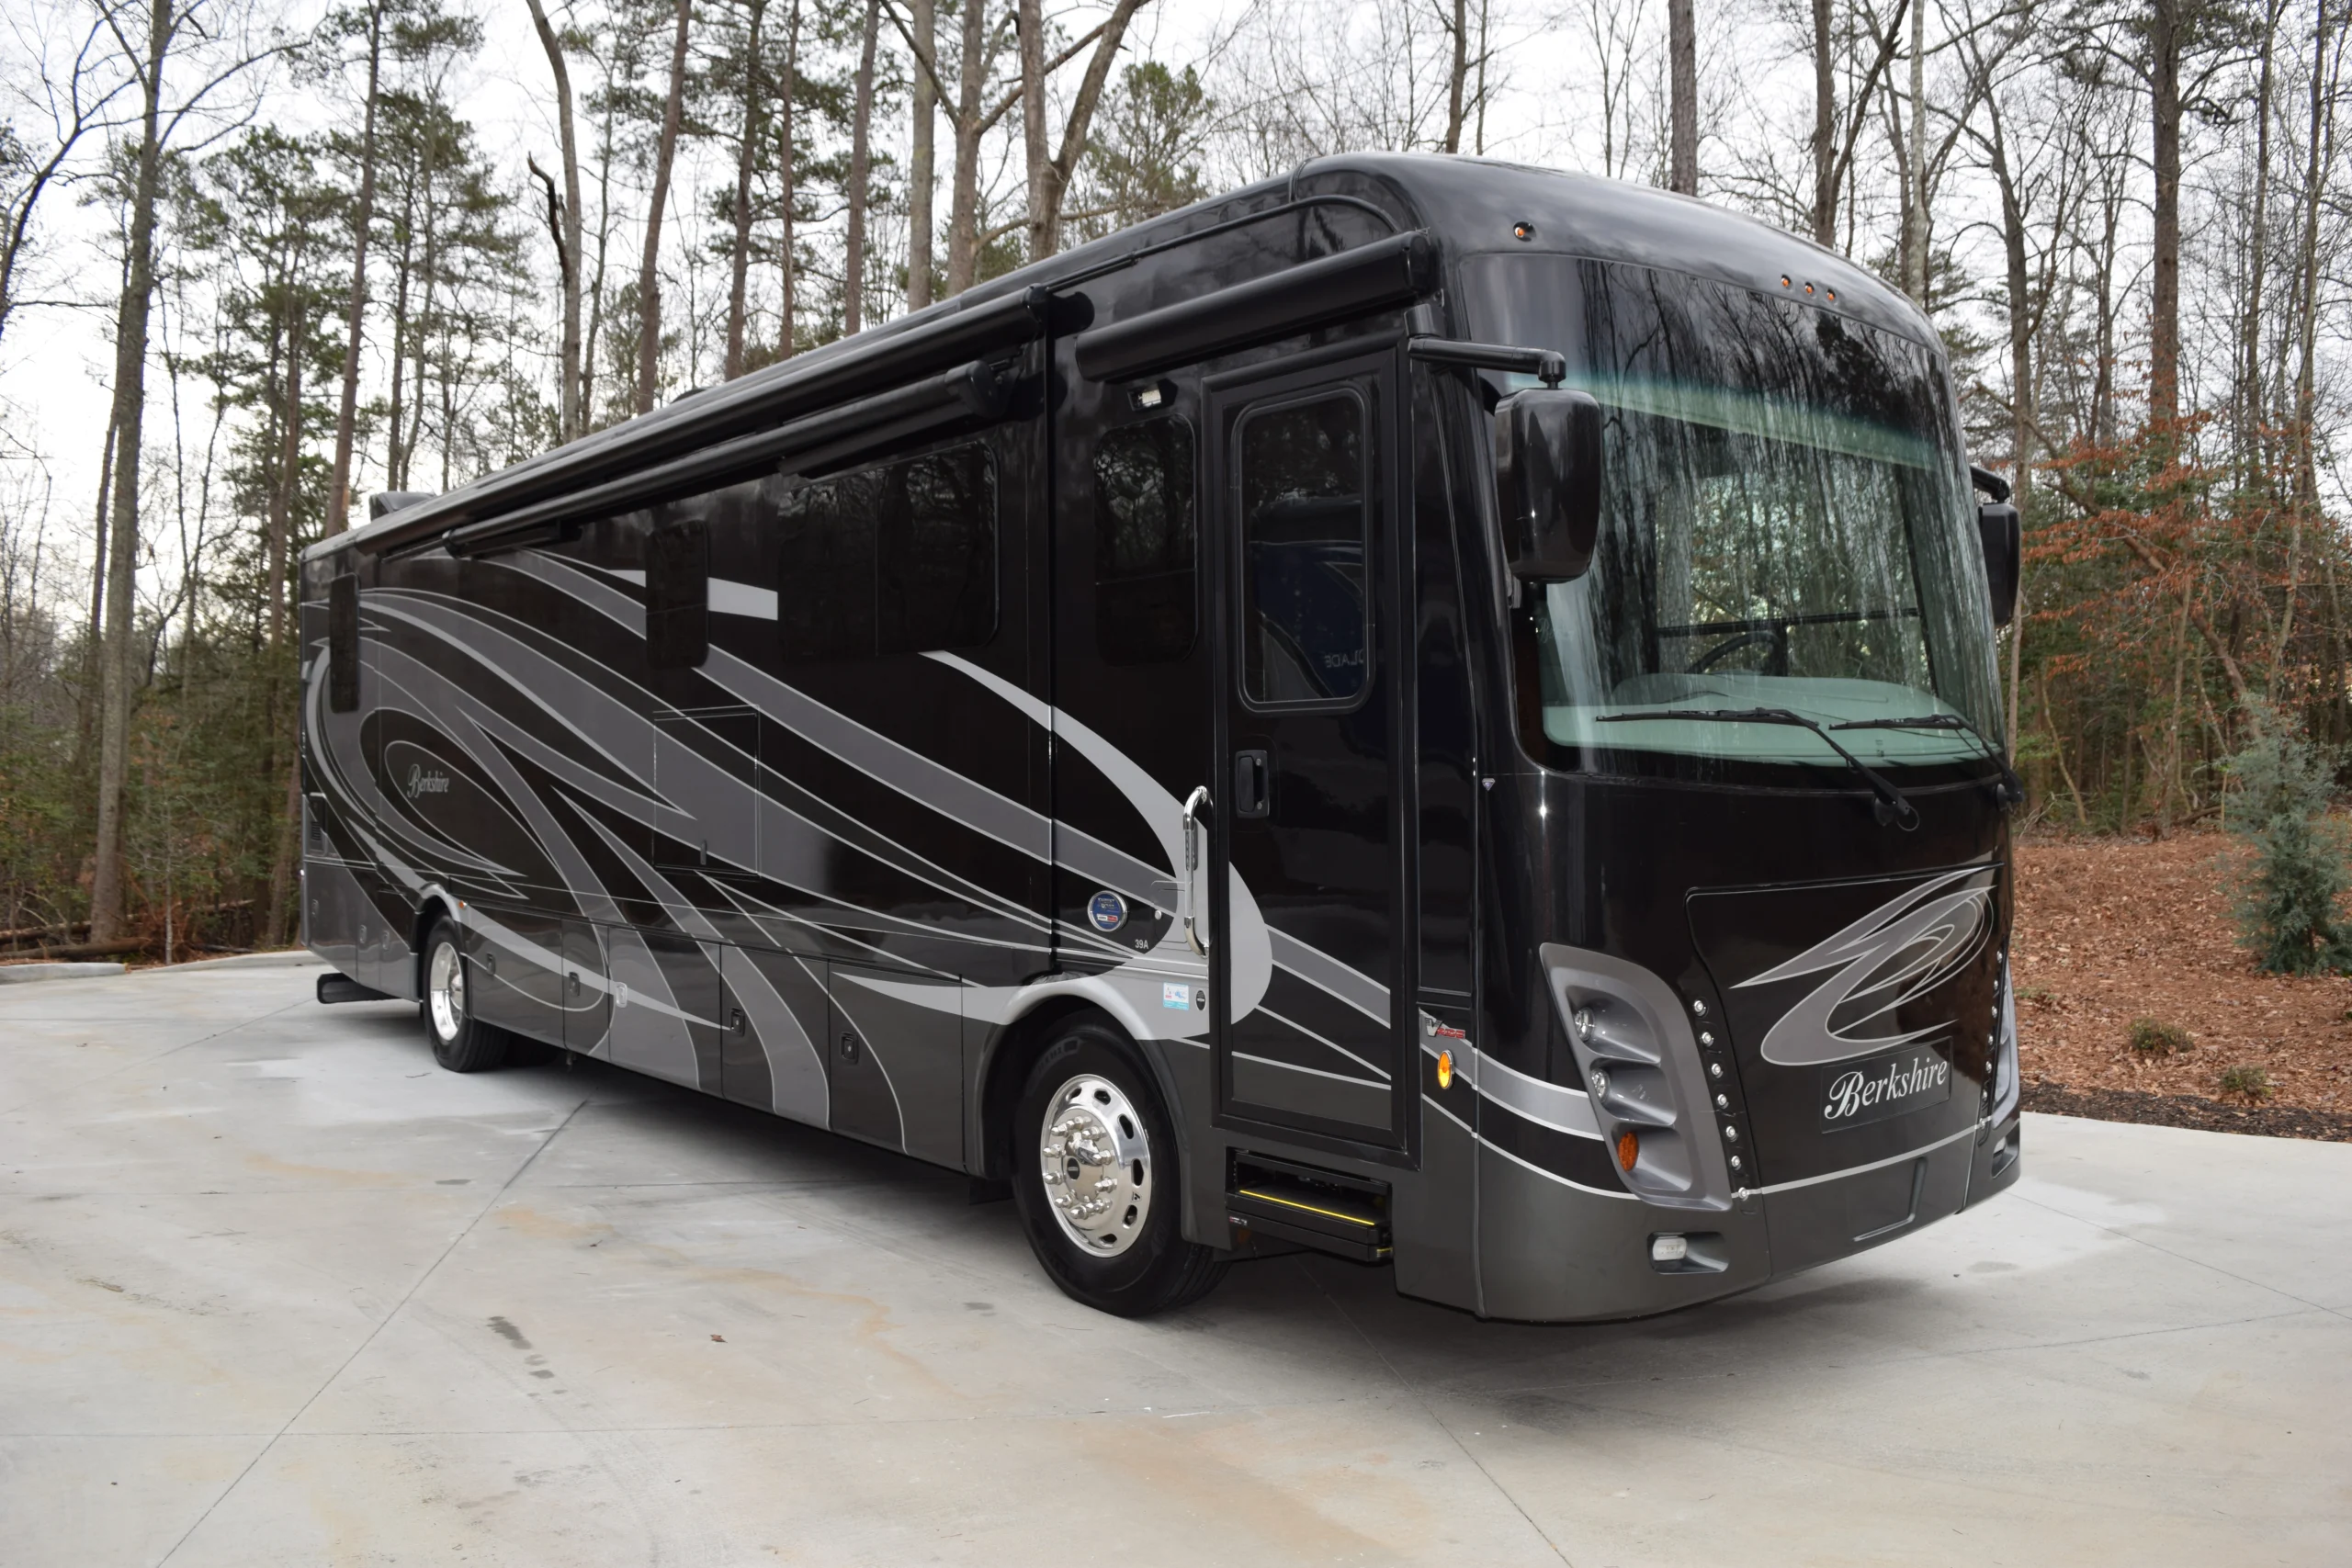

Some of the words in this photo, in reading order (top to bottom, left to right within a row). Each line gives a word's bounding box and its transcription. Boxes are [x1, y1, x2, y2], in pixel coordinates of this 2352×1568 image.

[407, 763, 449, 798] Berkshire
[1135, 939, 1148, 949] 39A
[1824, 1057, 1948, 1120] Berkshire
